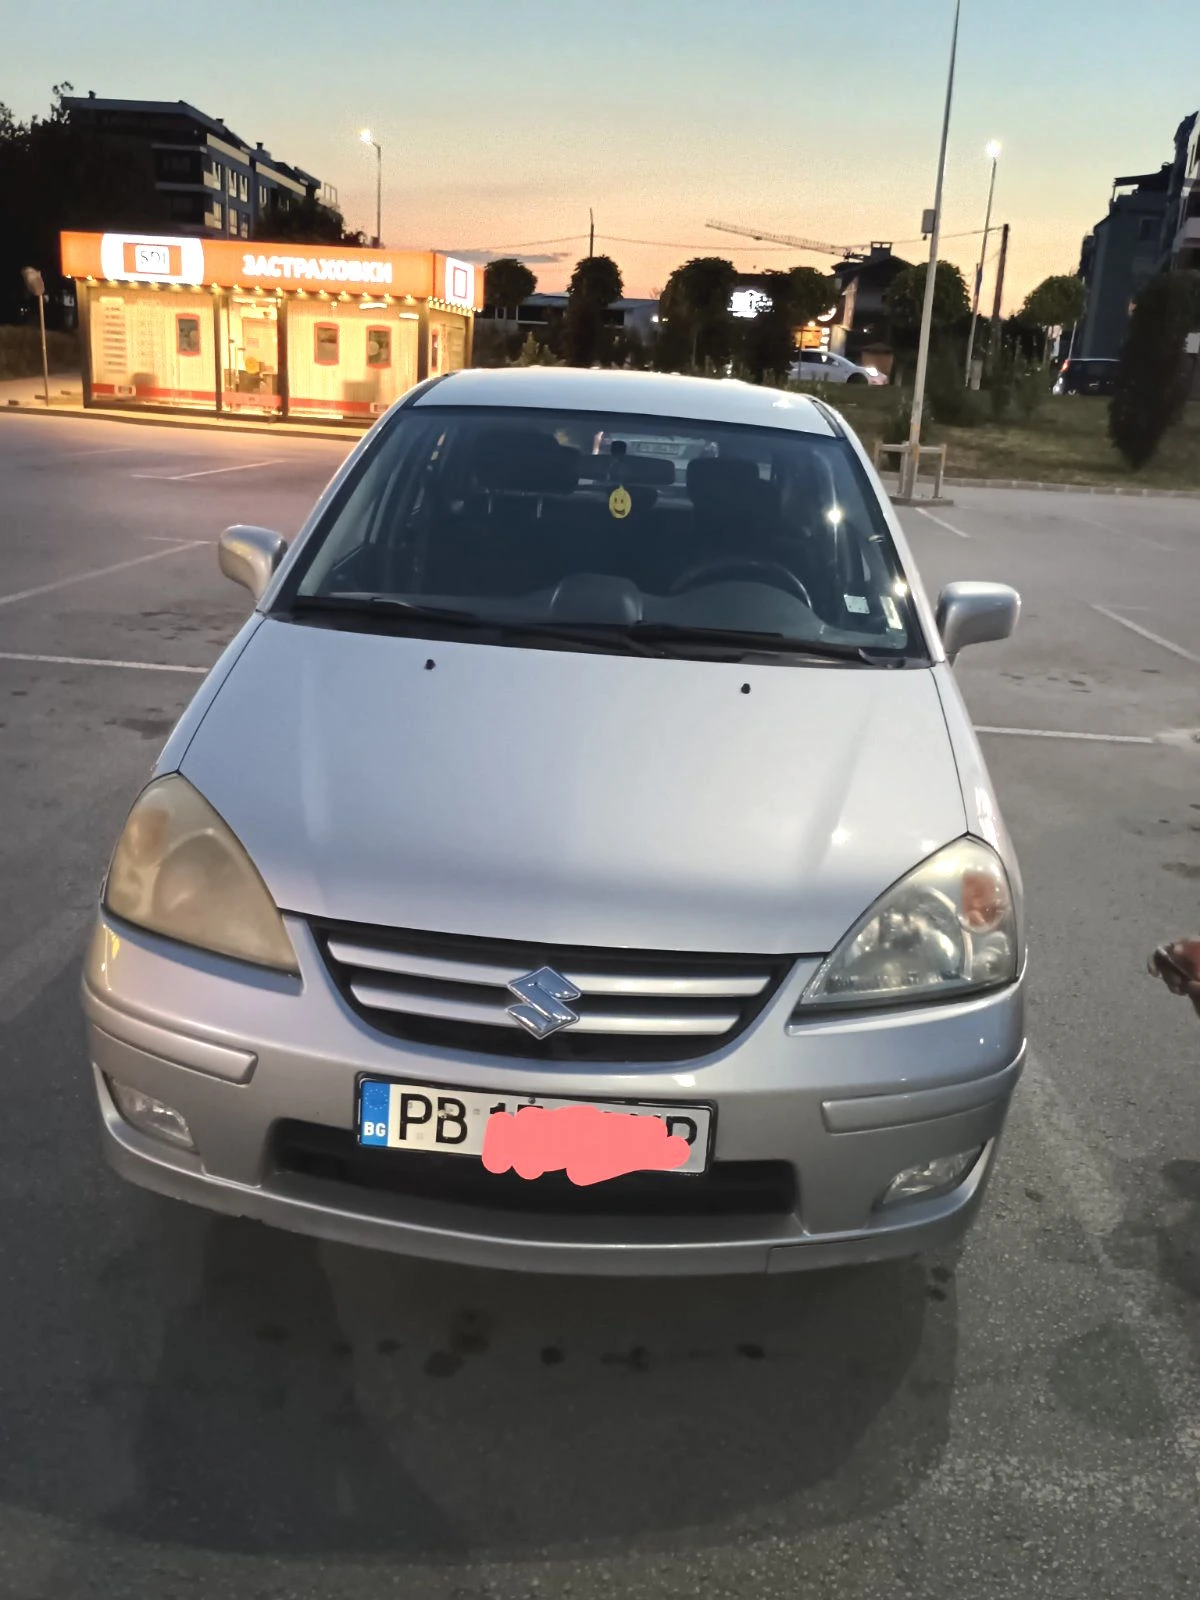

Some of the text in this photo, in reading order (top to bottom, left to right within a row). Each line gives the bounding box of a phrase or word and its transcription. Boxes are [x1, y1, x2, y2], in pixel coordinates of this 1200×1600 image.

[242, 254, 393, 284] ЗАСТРАХОВКИ
[363, 1121, 386, 1137] BG
[399, 1093, 468, 1145] PB
